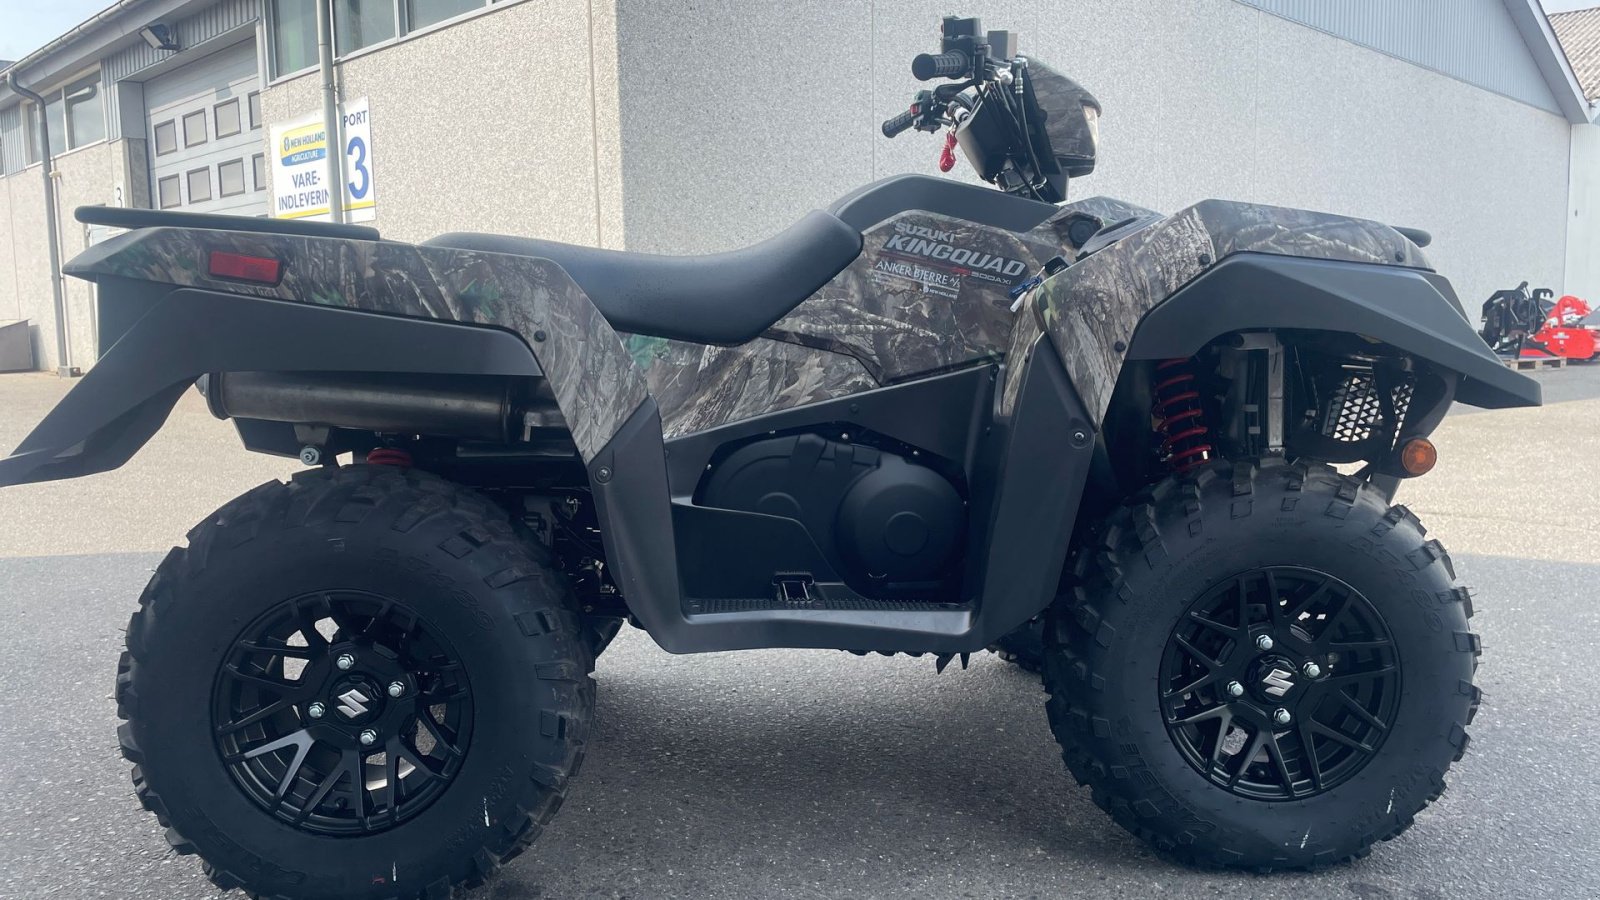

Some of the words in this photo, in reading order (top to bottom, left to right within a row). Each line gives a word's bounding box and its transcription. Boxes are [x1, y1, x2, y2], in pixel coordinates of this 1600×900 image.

[343, 110, 368, 128] PORT
[290, 137, 302, 148] NEW
[303, 131, 325, 145] HOLLAND
[347, 136, 369, 199] 3
[291, 170, 321, 189] VARE-
[278, 189, 330, 211] INDLEVERIN
[894, 222, 955, 243] SUZUKI
[887, 235, 1026, 276] KINGQUAD
[875, 260, 912, 277] ANKER
[913, 270, 948, 285] BJERRE
